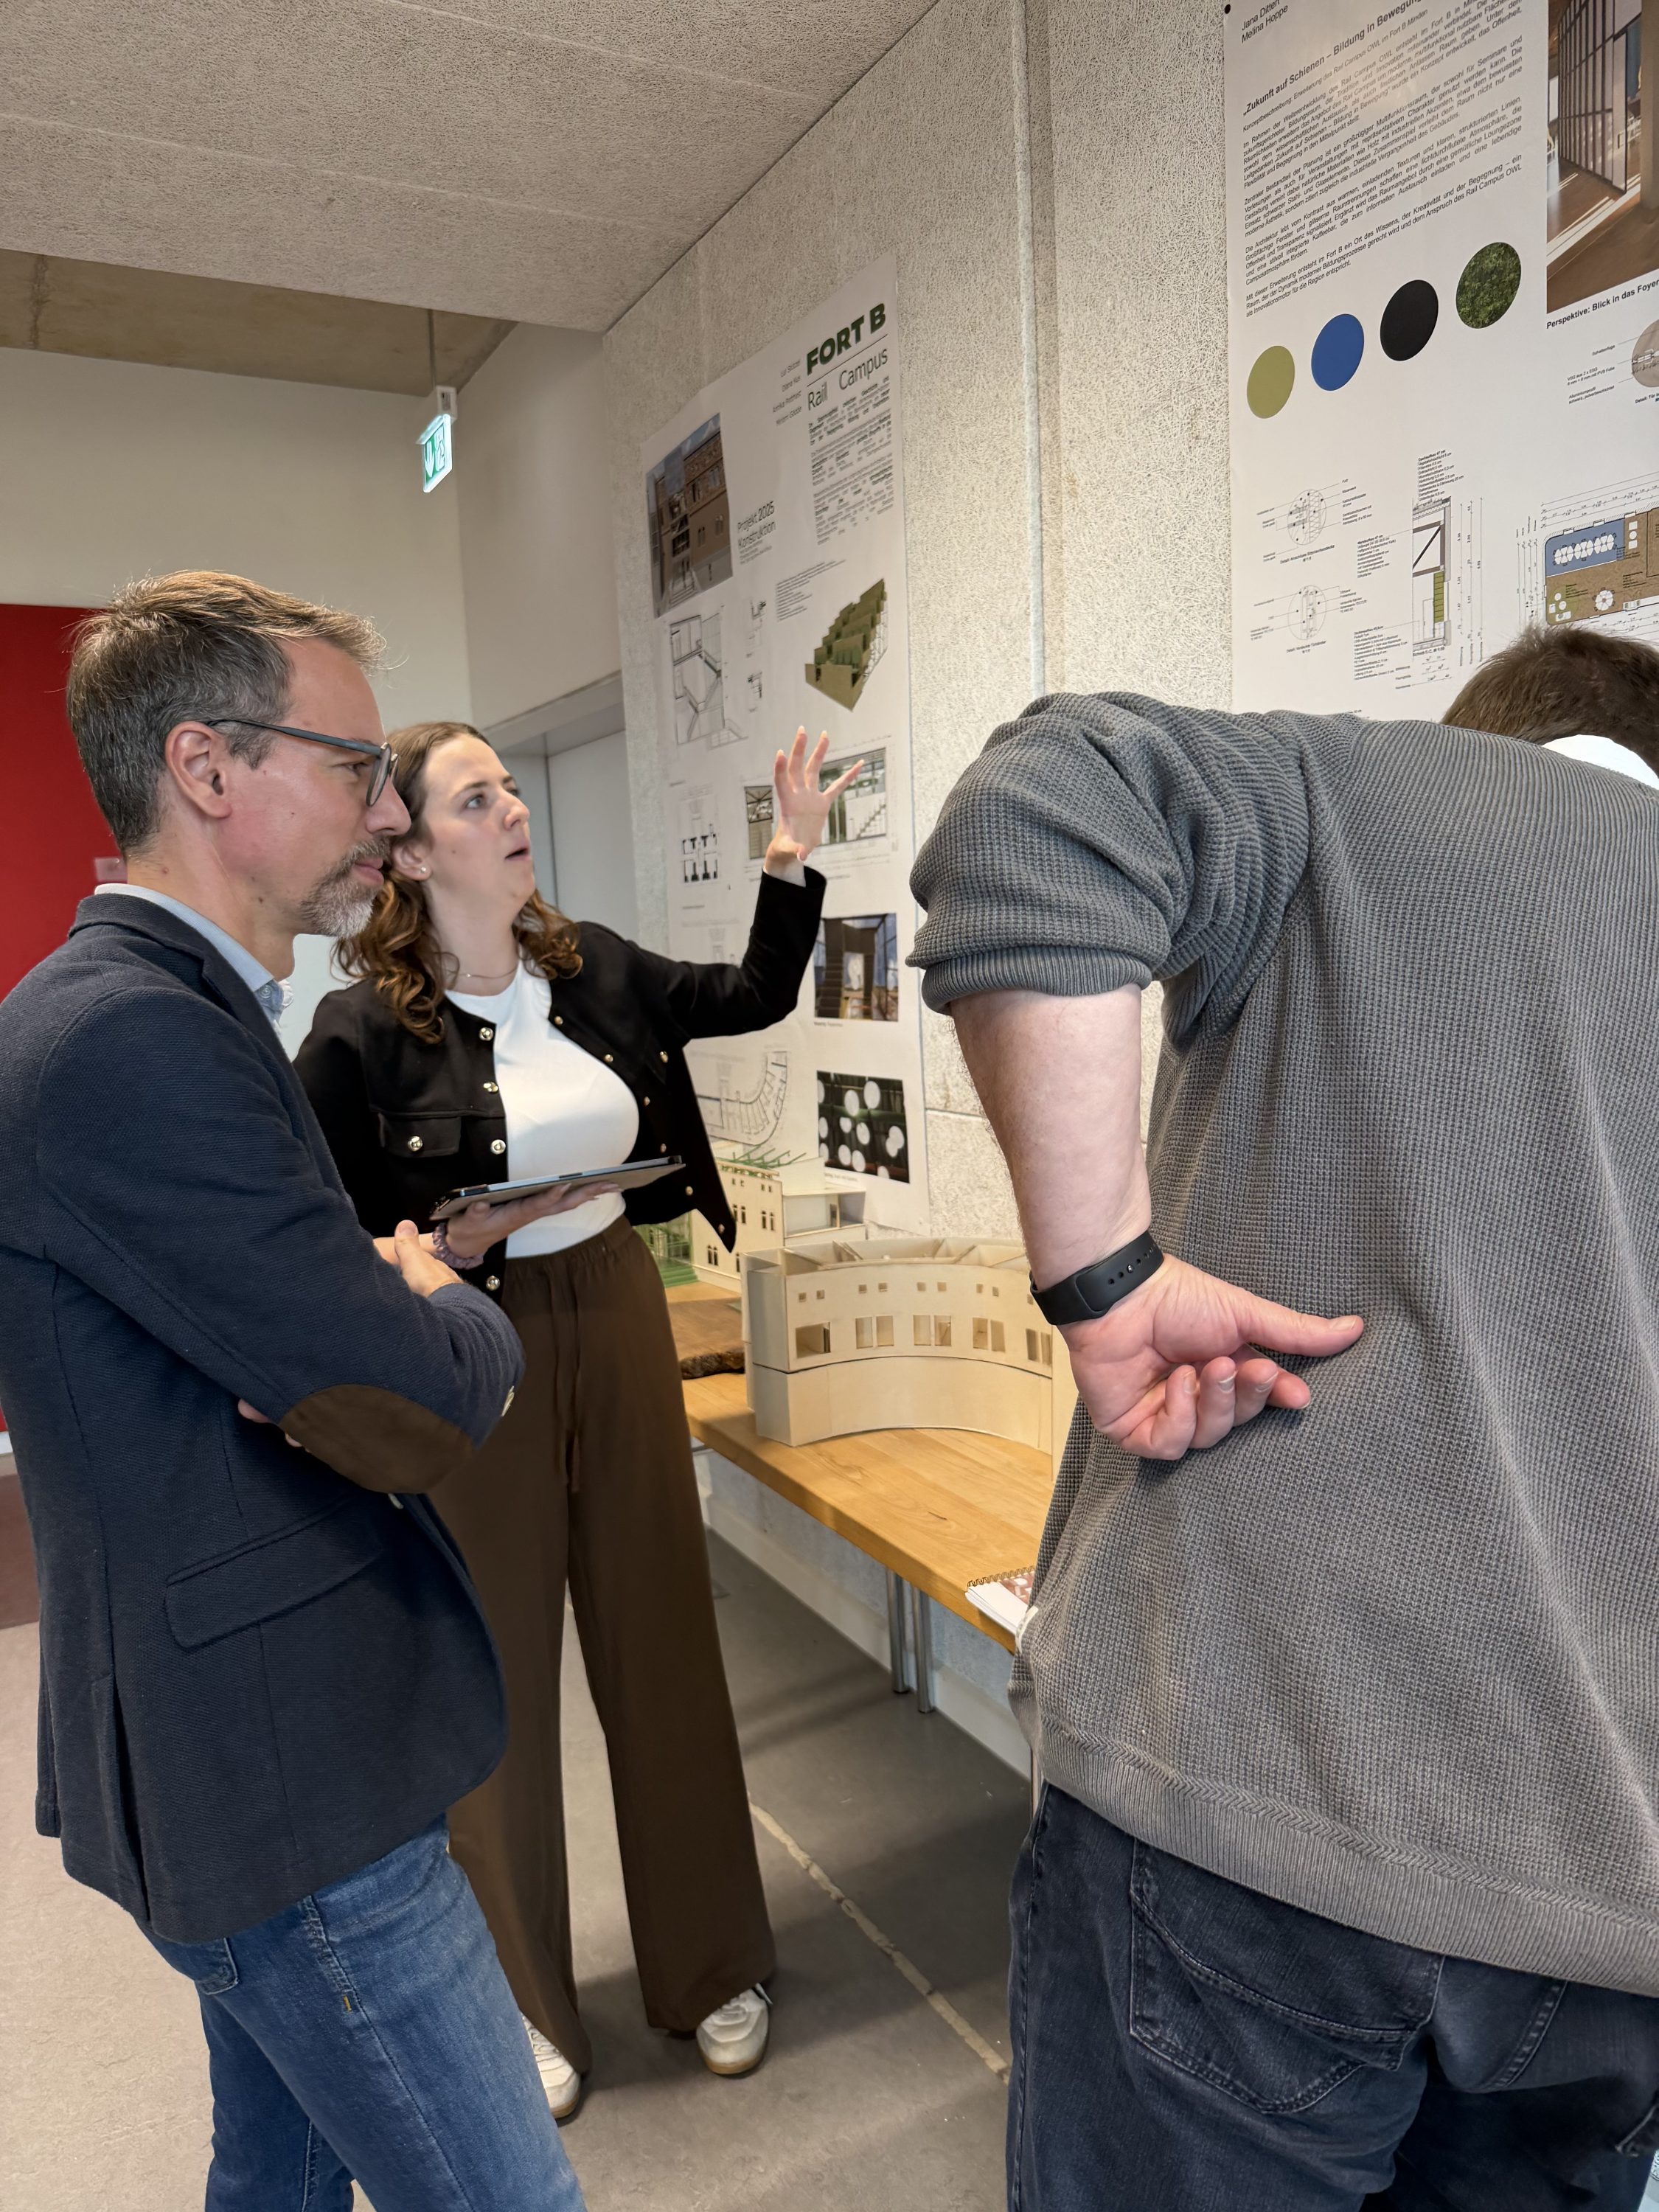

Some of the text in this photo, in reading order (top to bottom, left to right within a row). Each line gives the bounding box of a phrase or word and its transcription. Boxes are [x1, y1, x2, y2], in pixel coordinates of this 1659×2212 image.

[1242, 15, 1258, 31] Jana
[1242, 5, 1288, 44] Melina Hoppe
[1276, 77, 1287, 94] auf
[1289, 56, 1324, 84] Schienen
[1333, 29, 1365, 55] Bildung
[1367, 23, 1374, 33] in
[1389, 26, 1400, 38] Fort
[1420, 53, 1444, 73] Konzept
[1478, 26, 1490, 38] das
[1439, 7, 1504, 52] Raum Unter
[1303, 154, 1323, 170] Planung
[1333, 144, 1341, 152] ein
[1343, 124, 1374, 147] großzügiger
[1443, 69, 1464, 87] sowohl
[1466, 64, 1475, 74] für
[1477, 45, 1507, 66] Seminare
[1510, 35, 1522, 47] und
[1308, 149, 1348, 175] Veranstaltungen
[1351, 141, 1359, 151] mit
[1408, 97, 1435, 117] Charakter
[1439, 81, 1460, 101] genutzt
[1464, 67, 1486, 84] werden
[1512, 46, 1522, 57] Die
[1353, 66, 1522, 167] Dieses Zusammenspiel verleiht Raum nicht nur eine
[1367, 139, 1379, 150] Holz
[1391, 113, 1424, 136] industriellen
[1473, 77, 1486, 88] dem
[1489, 55, 1522, 80] bewussten
[1286, 239, 1309, 255] integrierte
[1340, 218, 1349, 226] die
[1352, 210, 1363, 220] zum
[1366, 193, 1395, 212] informellen
[1398, 175, 1427, 195] Austausch
[1430, 161, 1455, 177] einladen
[1458, 151, 1470, 163] und
[1474, 143, 1487, 154] eine
[1492, 125, 1522, 145] lebendige
[1290, 218, 1301, 227] vom
[1304, 204, 1324, 220] Kontrast
[1326, 199, 1335, 209] aus
[1362, 167, 1394, 188] einladenden
[1397, 152, 1420, 169] Texturen
[1423, 143, 1433, 155] und
[1458, 108, 1498, 135] strukturierten
[1296, 223, 1306, 233] und
[1308, 211, 1329, 228] gläserne
[1332, 185, 1376, 213] Raumtrennungen
[1380, 171, 1402, 187] schaffen
[1405, 162, 1418, 173] eine
[1421, 136, 1466, 164] lichtdurchflutete
[1512, 105, 1522, 115] die
[1319, 179, 1339, 195] zugleich
[1377, 135, 1416, 161] Vergangenheit
[1417, 129, 1428, 139] des
[1335, 205, 1354, 220] Ergänzt
[1355, 198, 1366, 209] wird
[1367, 193, 1377, 203] das
[1379, 170, 1416, 197] Raumangebot
[1419, 162, 1434, 175] durch
[1436, 155, 1449, 166] eine
[1450, 136, 1482, 160] gemütliche
[1484, 115, 1522, 140] Loungezone
[1298, 260, 1317, 274] entsteht
[1326, 249, 1337, 259] Fort
[1354, 236, 1362, 245] Ort
[1363, 231, 1374, 240] des
[1402, 211, 1411, 220] der
[1413, 195, 1441, 215] Kreativität
[1443, 187, 1454, 199] und
[1456, 182, 1466, 192] der
[1468, 164, 1503, 186] Begegnung
[1512, 154, 1522, 164] ein
[1298, 266, 1321, 282] moderner
[1322, 243, 1366, 270] Bildungsprozesse
[1367, 232, 1387, 248] gerecht
[1388, 224, 1399, 236] wird
[1400, 219, 1411, 230] und
[1412, 213, 1425, 223] dem
[1425, 199, 1453, 218] Anspruch
[1453, 193, 1464, 203] des
[1466, 184, 1478, 197] Rail
[1478, 173, 1504, 189] Campus
[1506, 164, 1521, 175] OWL
[1307, 273, 1325, 286] Region
[1546, 307, 1590, 329] Perspektive:
[1592, 298, 1610, 311] Blick
[1613, 295, 1620, 303] in
[1621, 289, 1635, 299] das
[807, 315, 864, 375] FORT
[870, 303, 886, 334] B
[808, 382, 827, 411] Rail
[839, 349, 888, 390] Campus
